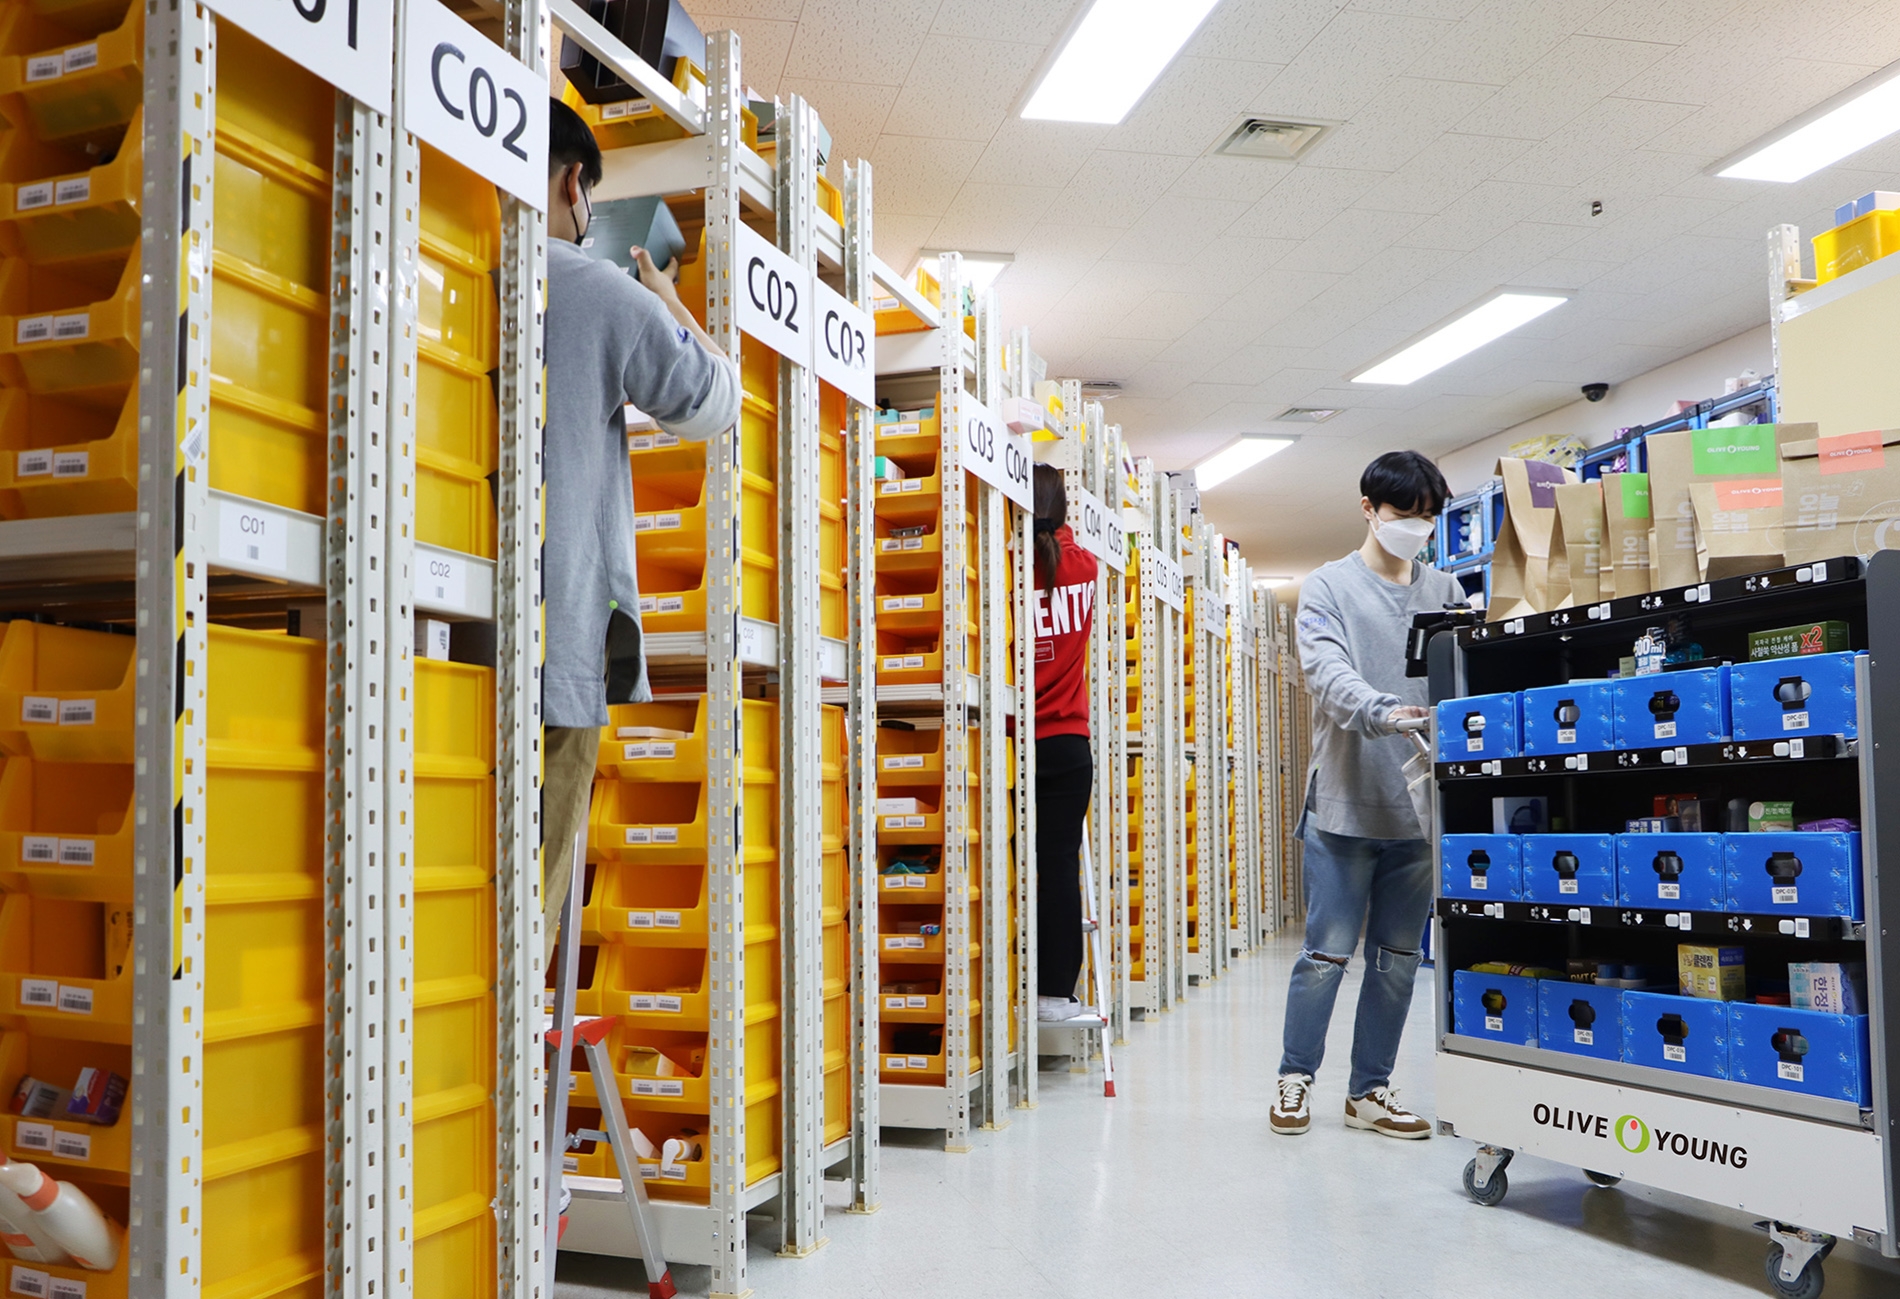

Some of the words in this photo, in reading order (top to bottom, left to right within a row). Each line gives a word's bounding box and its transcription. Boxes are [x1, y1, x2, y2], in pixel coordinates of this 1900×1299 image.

[431, 42, 528, 163] C02
[748, 256, 799, 334] C02
[825, 310, 866, 370] C03
[968, 417, 994, 463] C03
[1005, 443, 1029, 490] C04
[1798, 492, 1839, 512] 오늘
[240, 515, 265, 536] C01
[1084, 504, 1101, 541] C04
[1108, 522, 1123, 556] C05
[1796, 512, 1838, 532] 드림
[430, 560, 451, 579] C02
[1156, 560, 1168, 588] C05
[743, 627, 754, 640] C02
[1770, 643, 1790, 655] 약산성
[1791, 641, 1799, 653] 폼
[1693, 954, 1713, 968] 클렌징
[1813, 976, 1829, 1013] 한정
[1533, 1103, 1608, 1139] OLIVE
[1654, 1128, 1748, 1169] YOUNG
